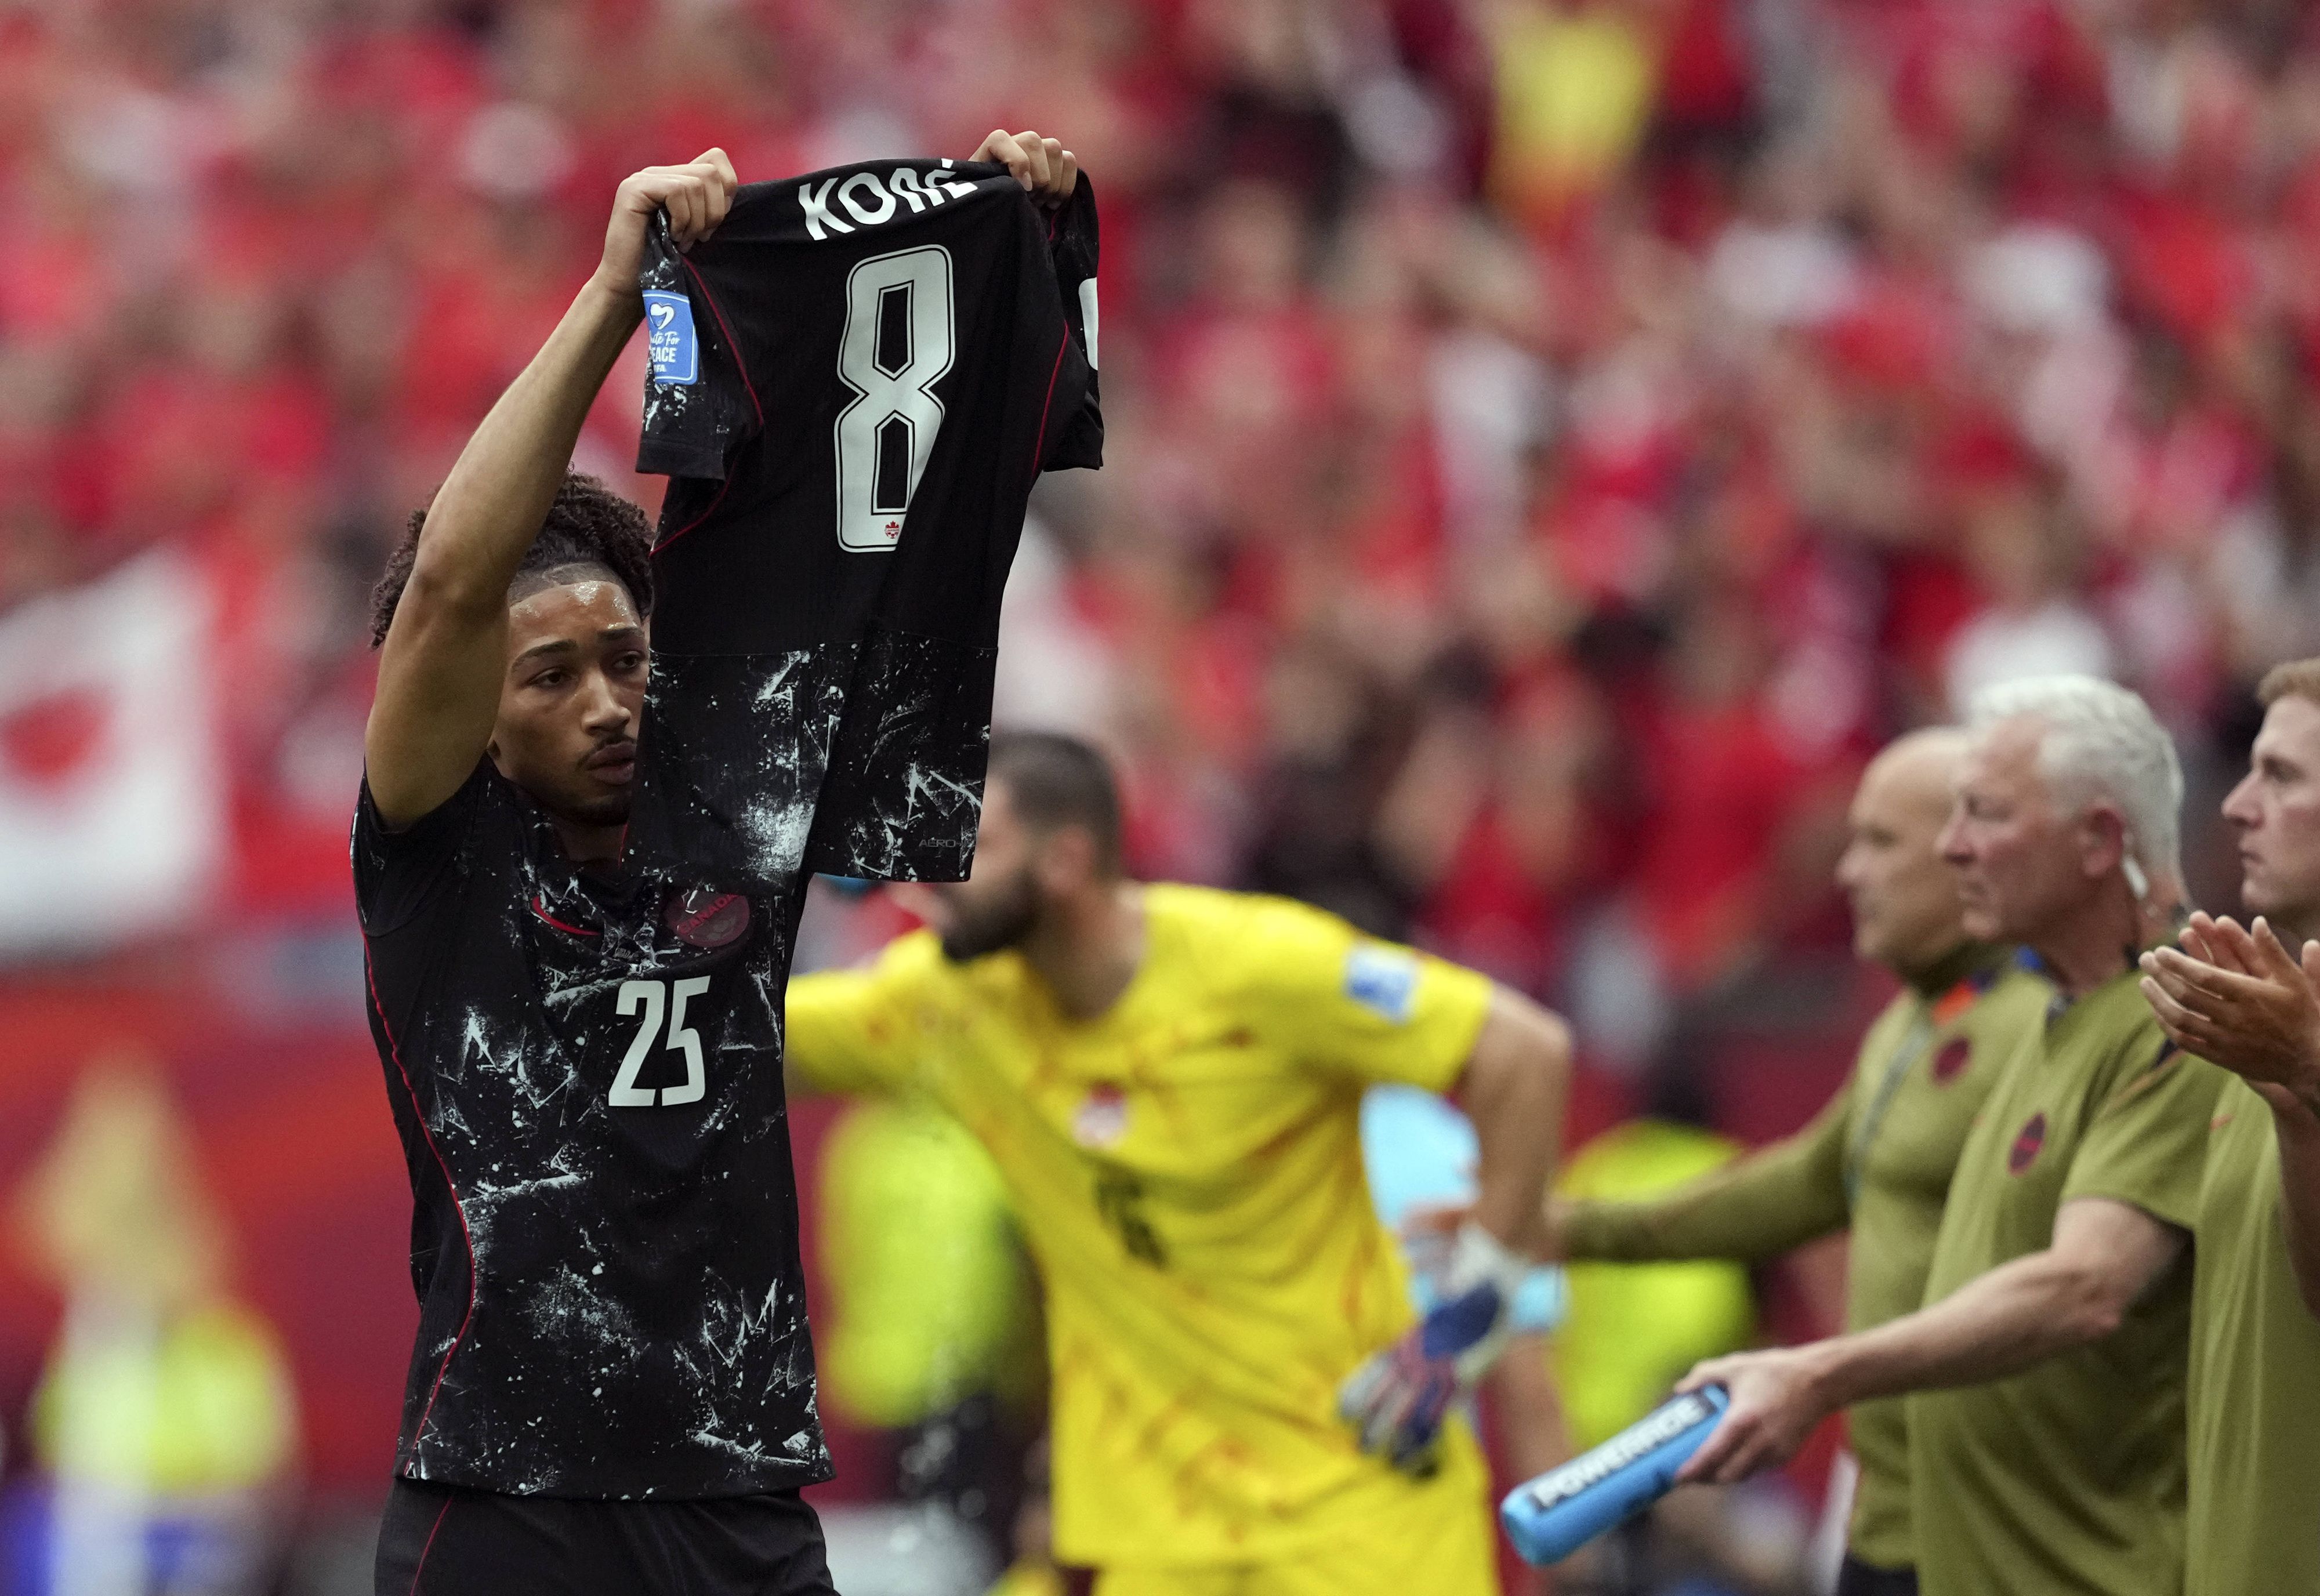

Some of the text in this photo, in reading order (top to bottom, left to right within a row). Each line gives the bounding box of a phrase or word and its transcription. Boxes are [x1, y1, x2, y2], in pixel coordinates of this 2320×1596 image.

[650, 346, 677, 363] EACE
[665, 331, 680, 346] For
[835, 244, 956, 553] 8
[608, 975, 711, 1107] 25
[1532, 1395, 1705, 1508] POWERADE
